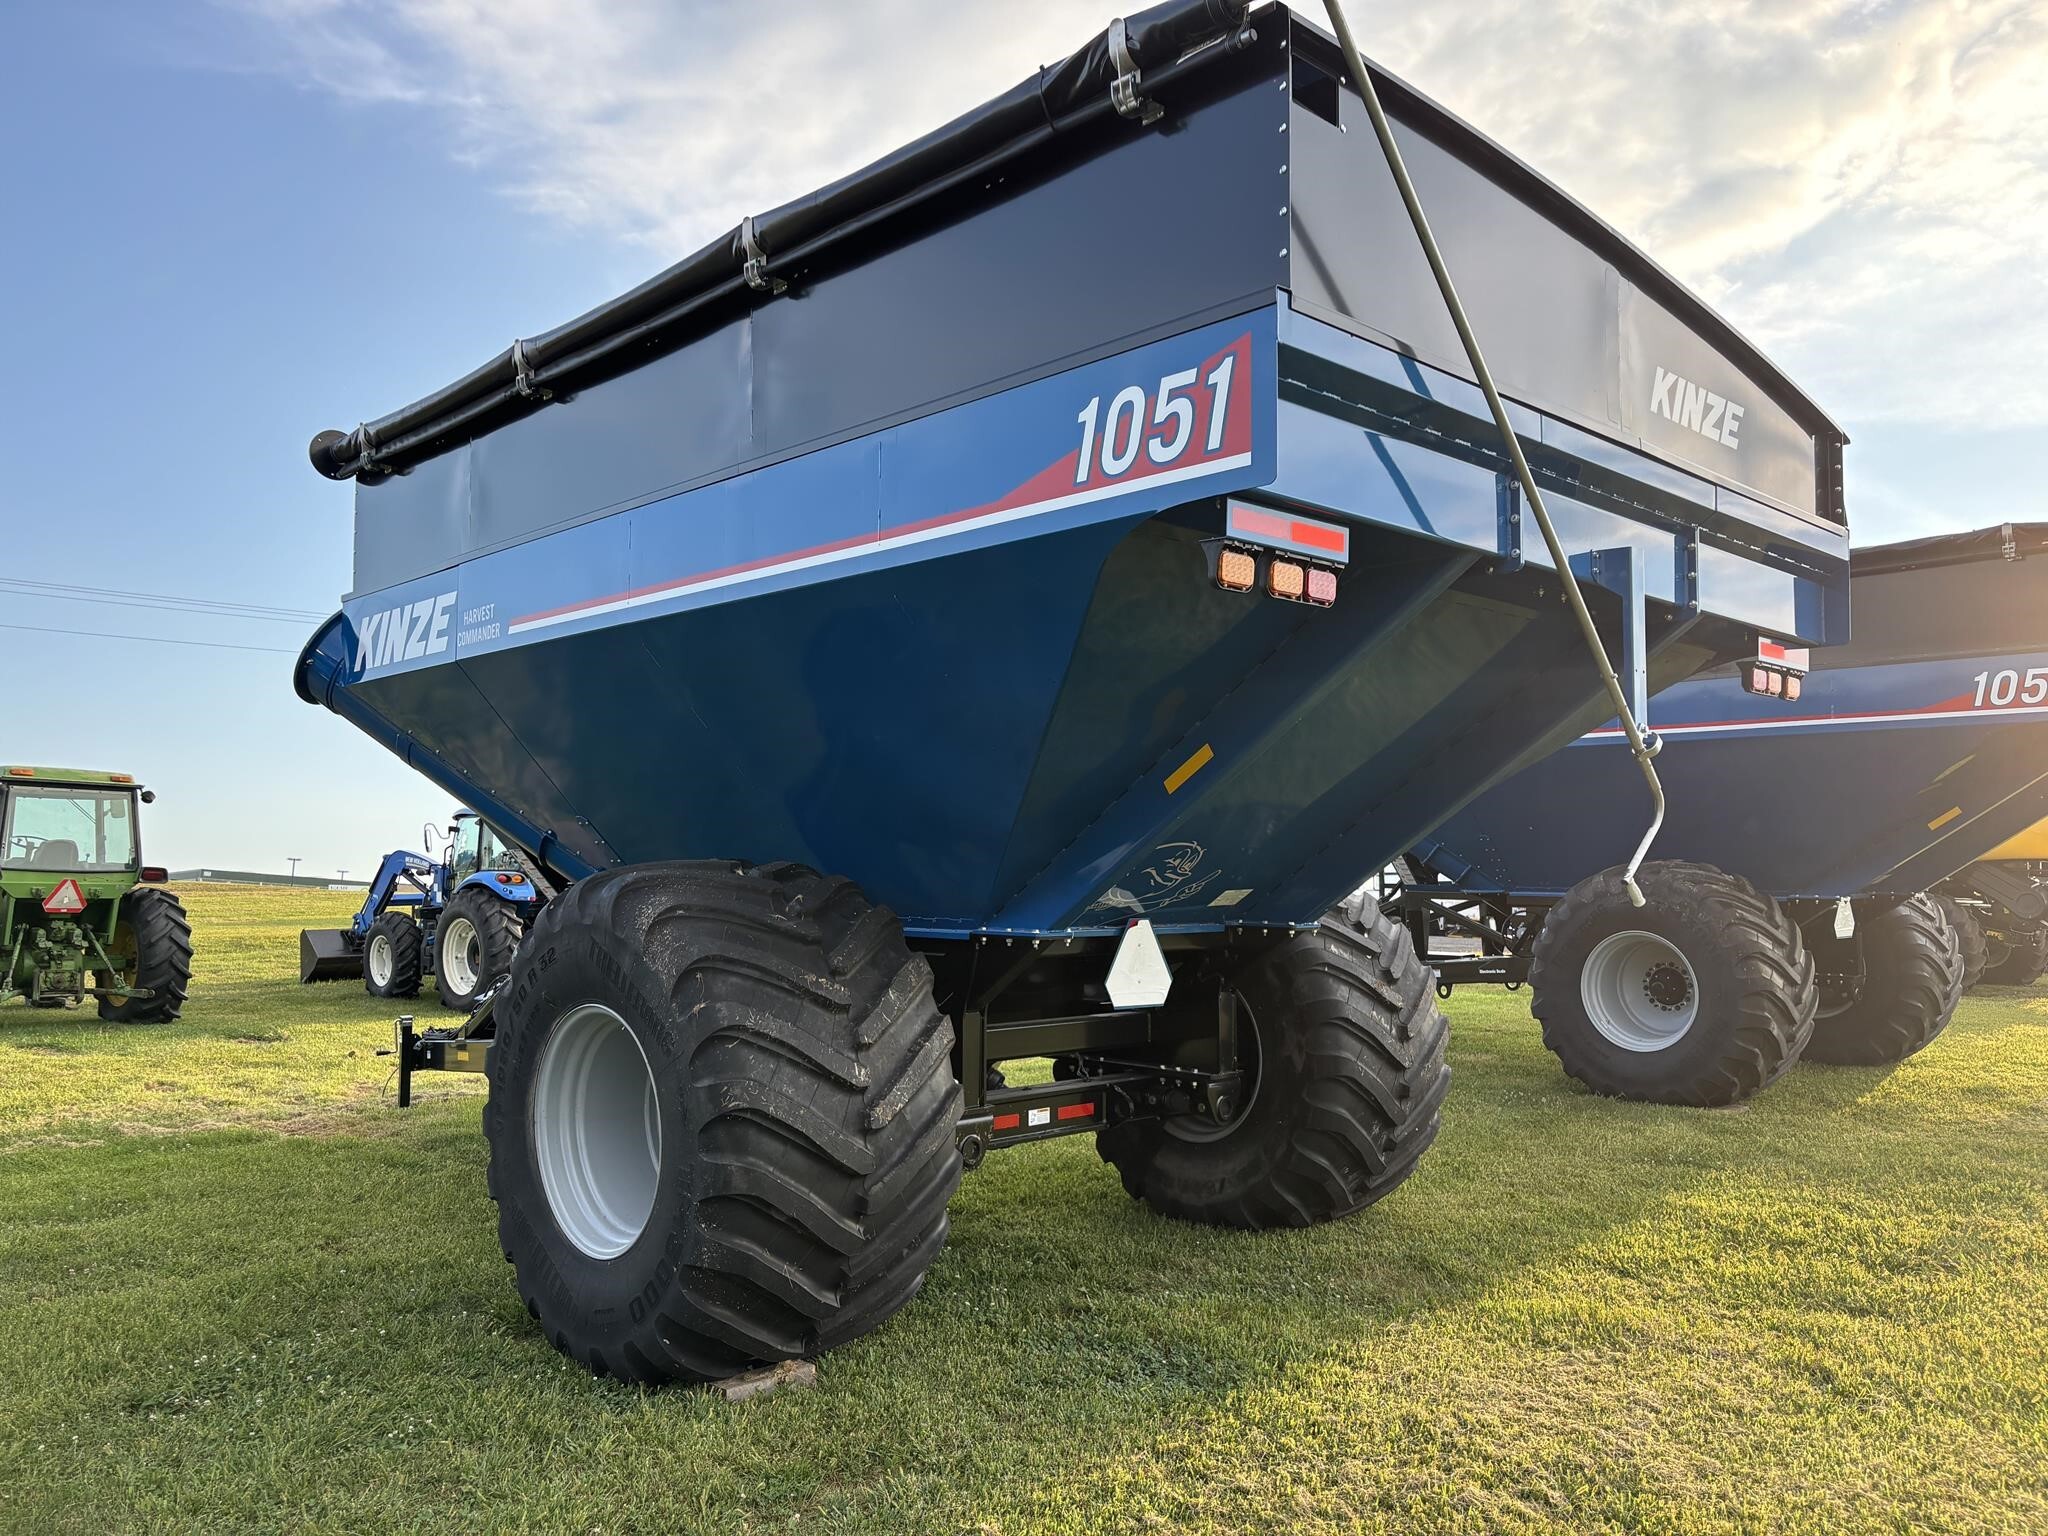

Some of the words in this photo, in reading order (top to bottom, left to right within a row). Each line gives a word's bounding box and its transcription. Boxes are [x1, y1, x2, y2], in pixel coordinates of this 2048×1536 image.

[1075, 354, 1235, 484] 1051
[1649, 366, 1745, 450] KINZE
[353, 590, 458, 672] KINZE
[463, 603, 495, 625] HARVEST
[457, 623, 500, 647] COMMANDER
[1972, 667, 2048, 707] 105
[537, 946, 559, 971] 32
